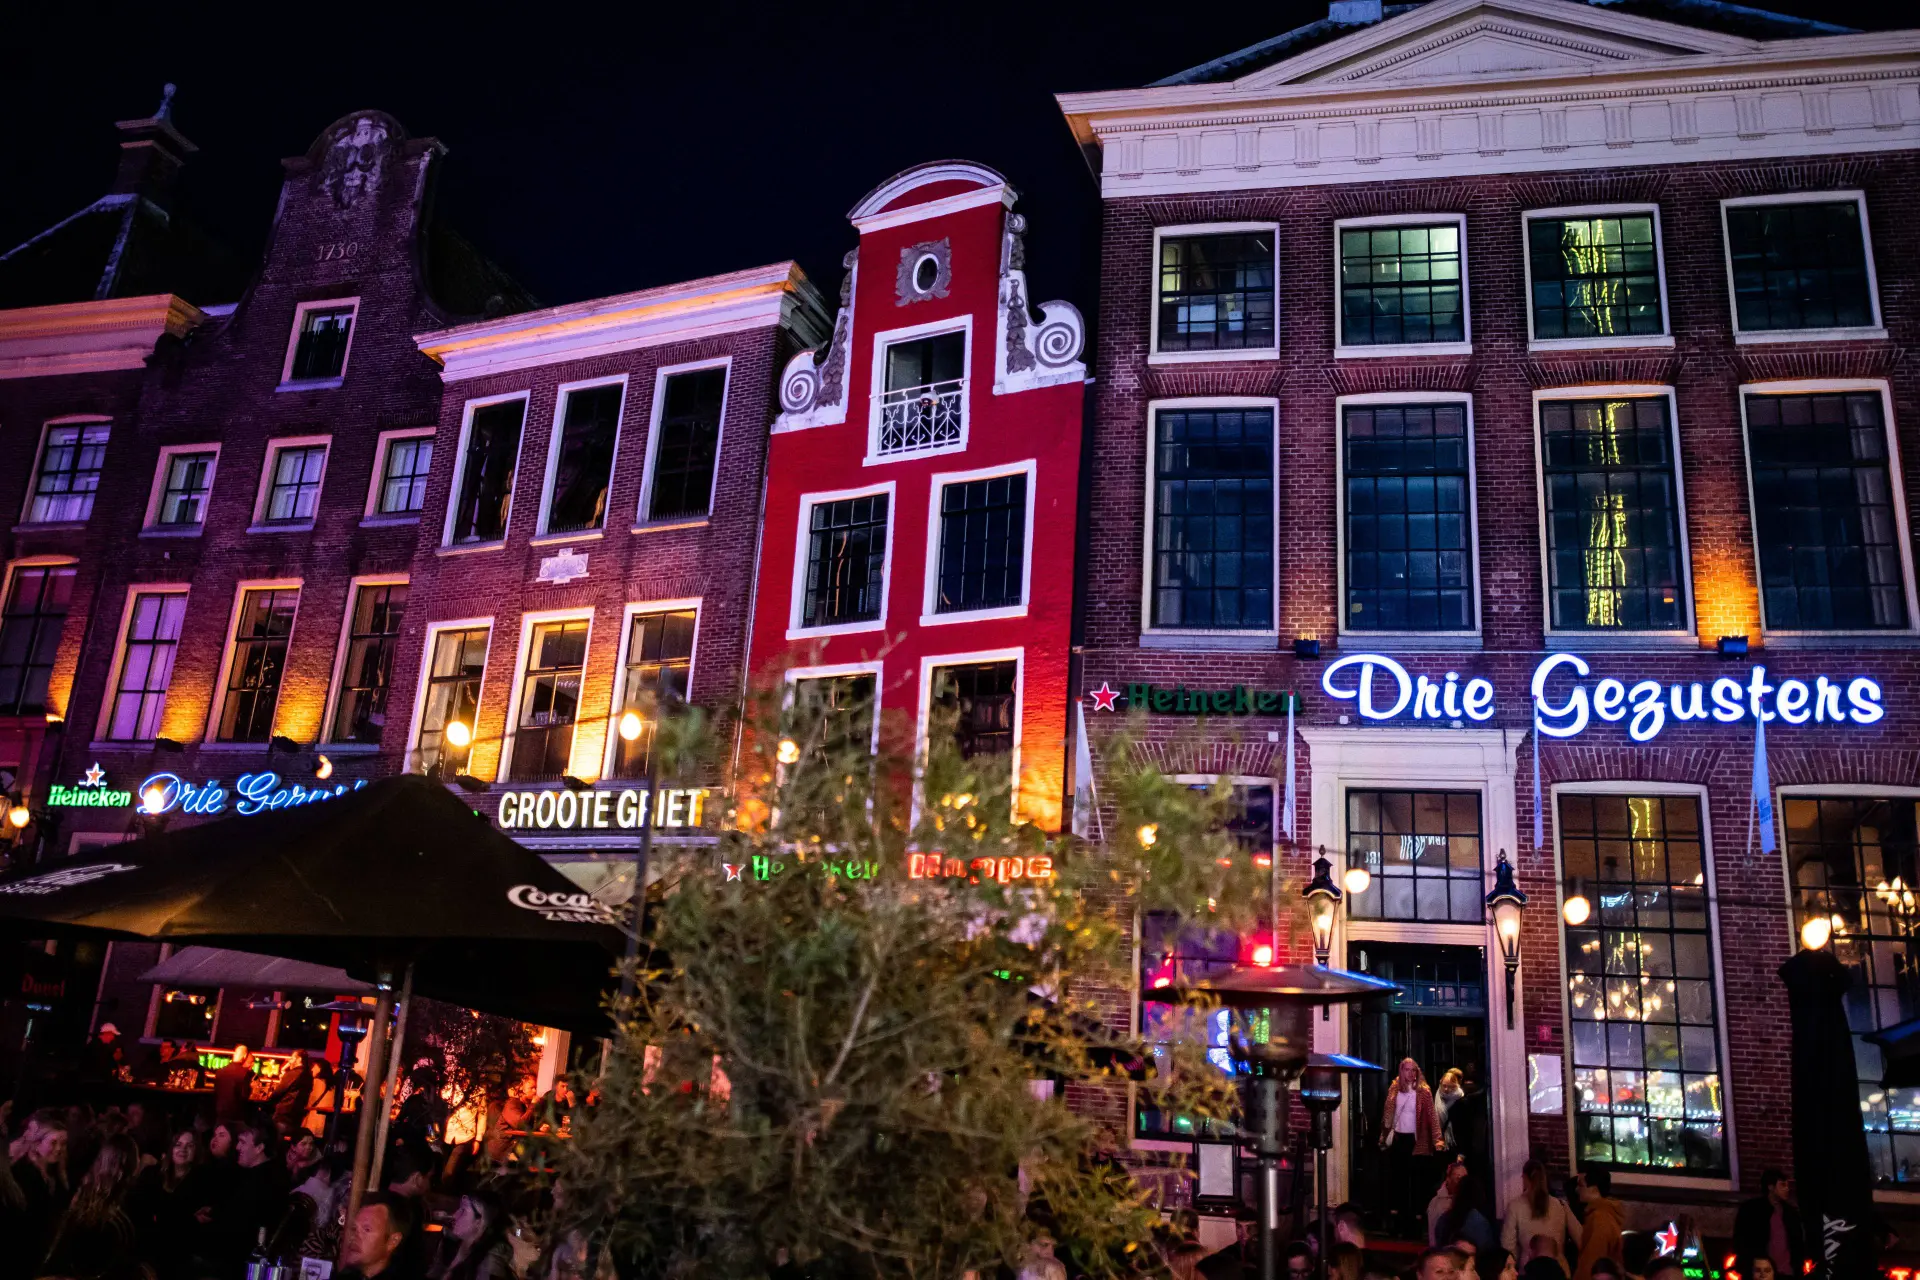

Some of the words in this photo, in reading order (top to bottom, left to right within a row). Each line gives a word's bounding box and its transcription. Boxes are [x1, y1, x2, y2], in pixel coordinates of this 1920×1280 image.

[1127, 682, 1302, 713] Heineken
[1322, 653, 1495, 721] Drie
[1531, 652, 1884, 742] Gezusters
[47, 783, 132, 807] Heineken
[136, 772, 224, 814] Drie
[499, 789, 611, 829] GROOTE
